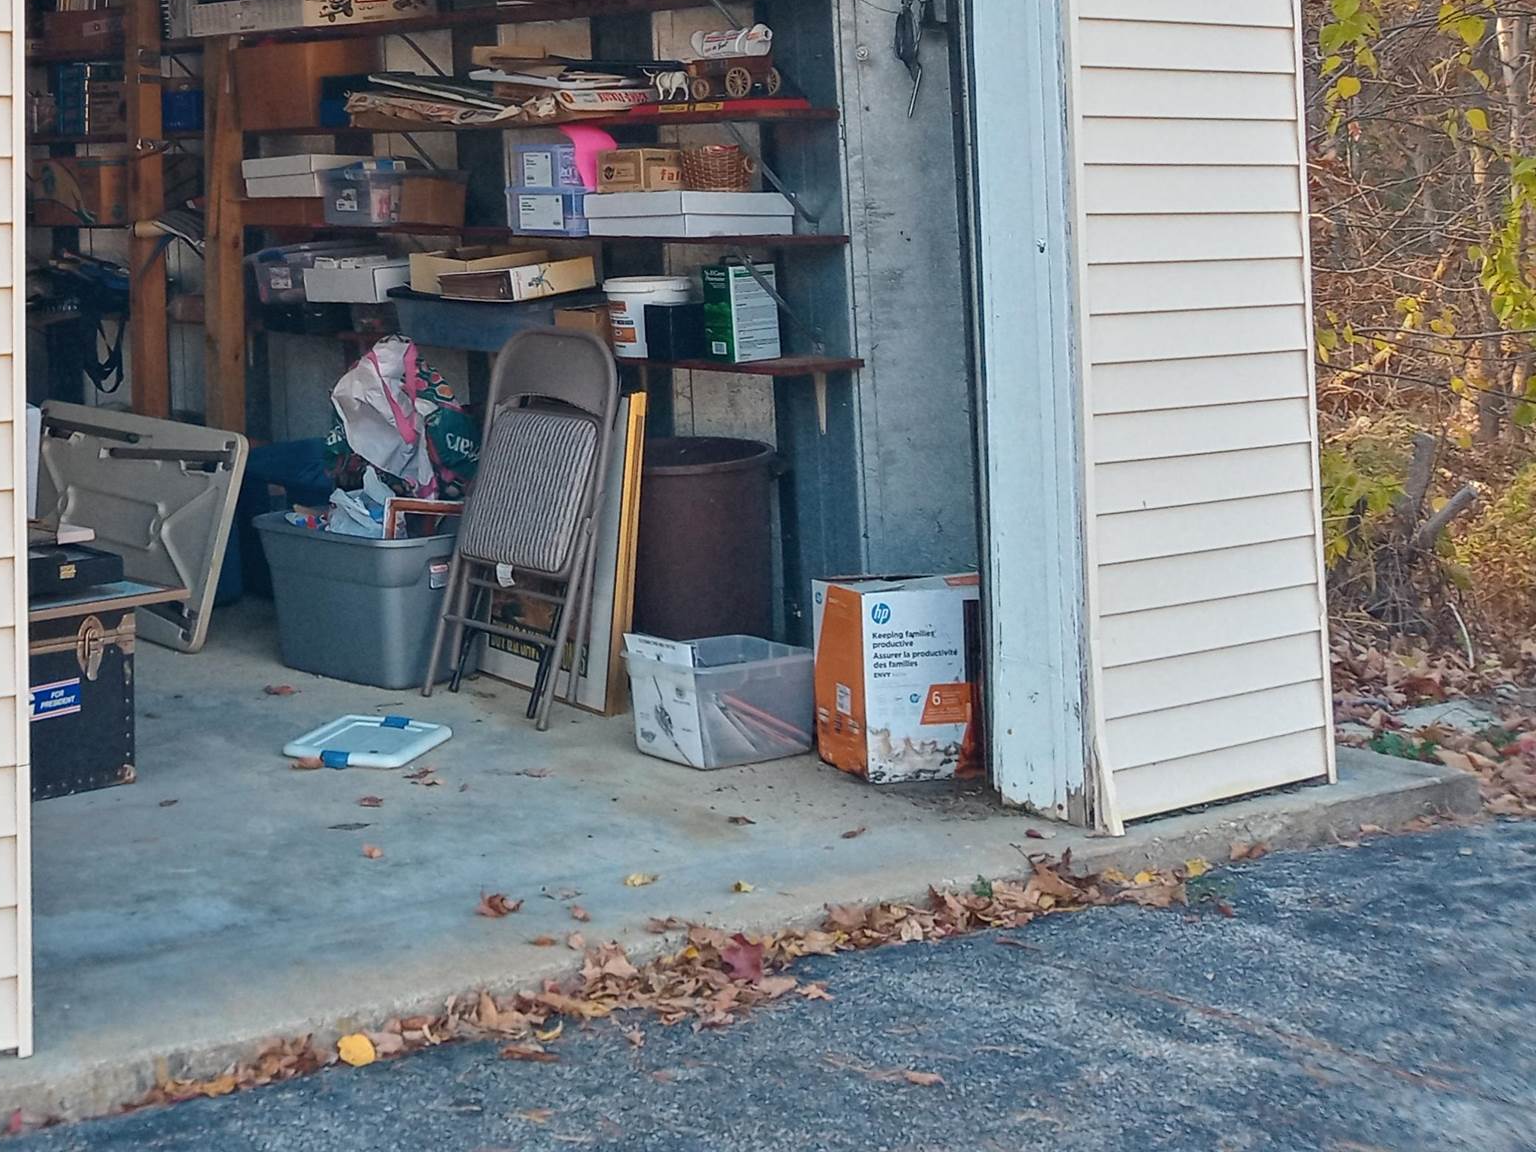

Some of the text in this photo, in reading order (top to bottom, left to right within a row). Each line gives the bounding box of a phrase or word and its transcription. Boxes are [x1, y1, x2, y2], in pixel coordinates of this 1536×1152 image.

[872, 603, 891, 624] hp
[872, 641, 914, 649] productive
[912, 649, 958, 658] productivité
[50, 689, 65, 699] FOR
[932, 691, 941, 706] 6
[40, 695, 76, 710] PRESIDENT
